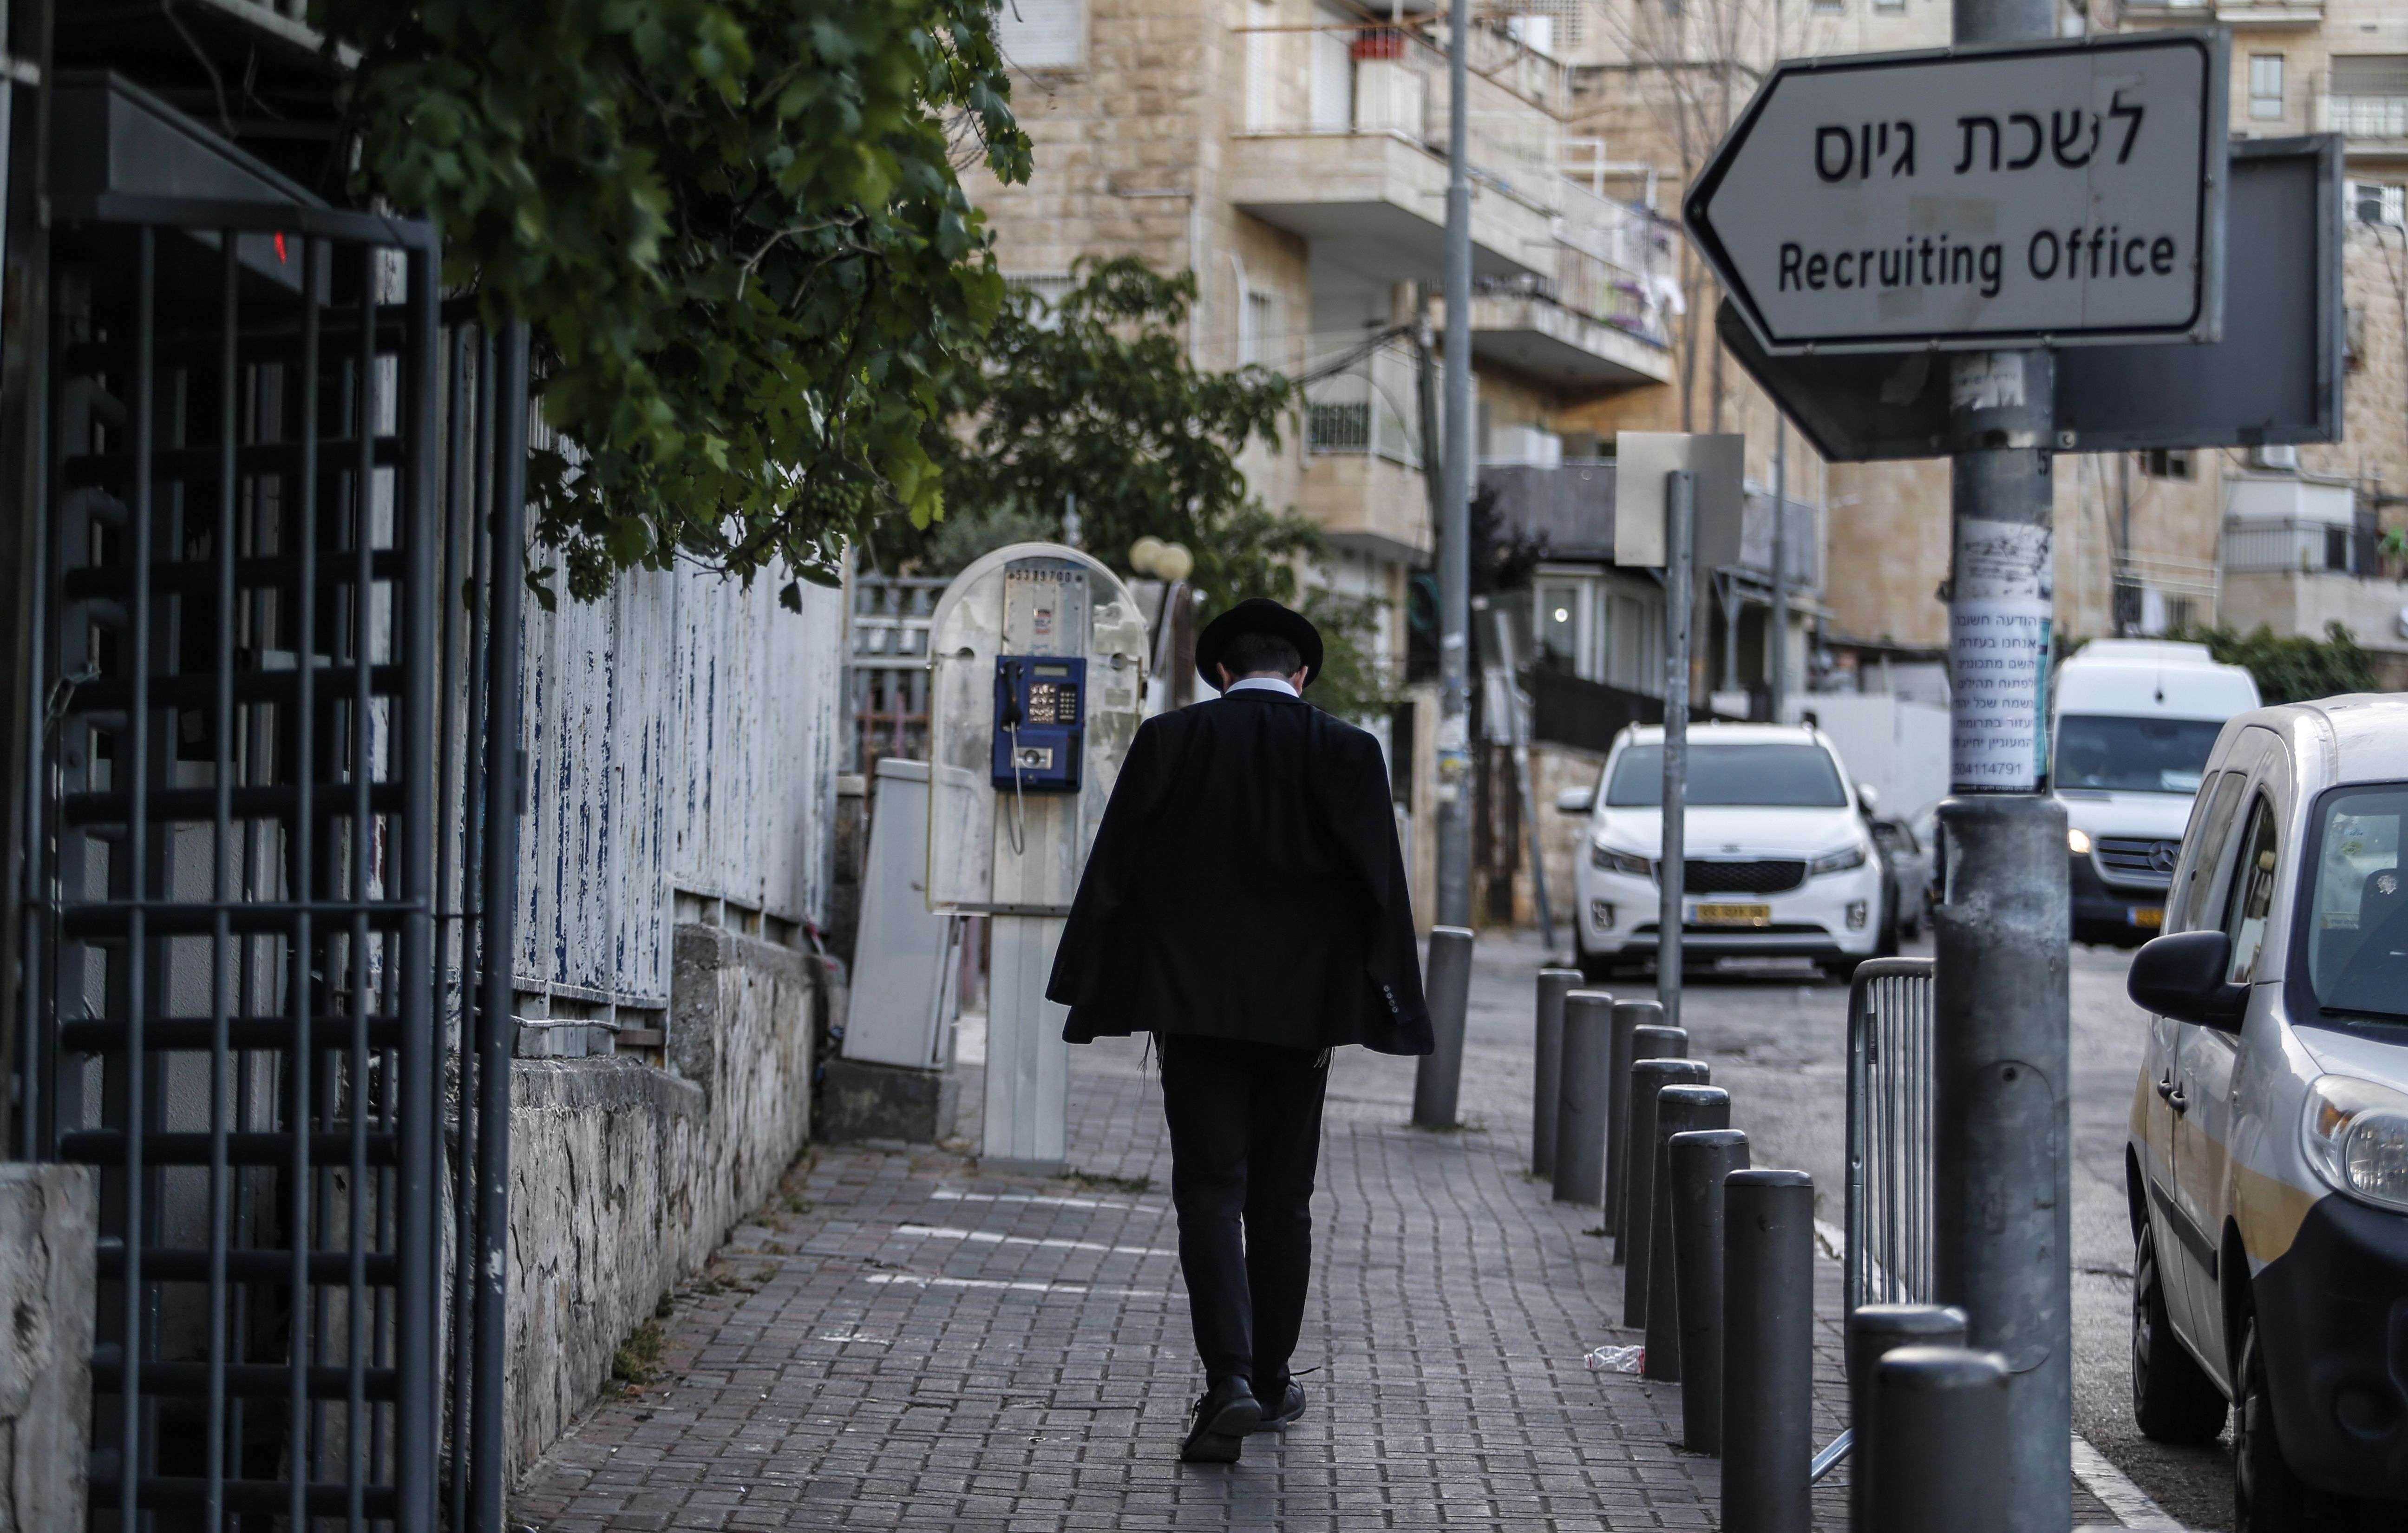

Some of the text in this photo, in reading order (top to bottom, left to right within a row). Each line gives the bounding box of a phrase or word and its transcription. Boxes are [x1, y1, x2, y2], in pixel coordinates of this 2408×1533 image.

[1814, 90, 2145, 184] לשכת גיוס
[1778, 225, 2176, 299] Recruiting Office
[1996, 616, 2036, 626] הודעה
[1959, 638, 2036, 649] אנחנו בעזרת
[1957, 659, 2034, 669] השם מתכוננים
[1958, 677, 2034, 688] לפתוח תהילים
[1974, 696, 1997, 708] שכל
[2002, 699, 2033, 708] נשמח
[1956, 719, 2033, 728] יעזור בתרומות
[1989, 738, 2032, 750] המעוניין
